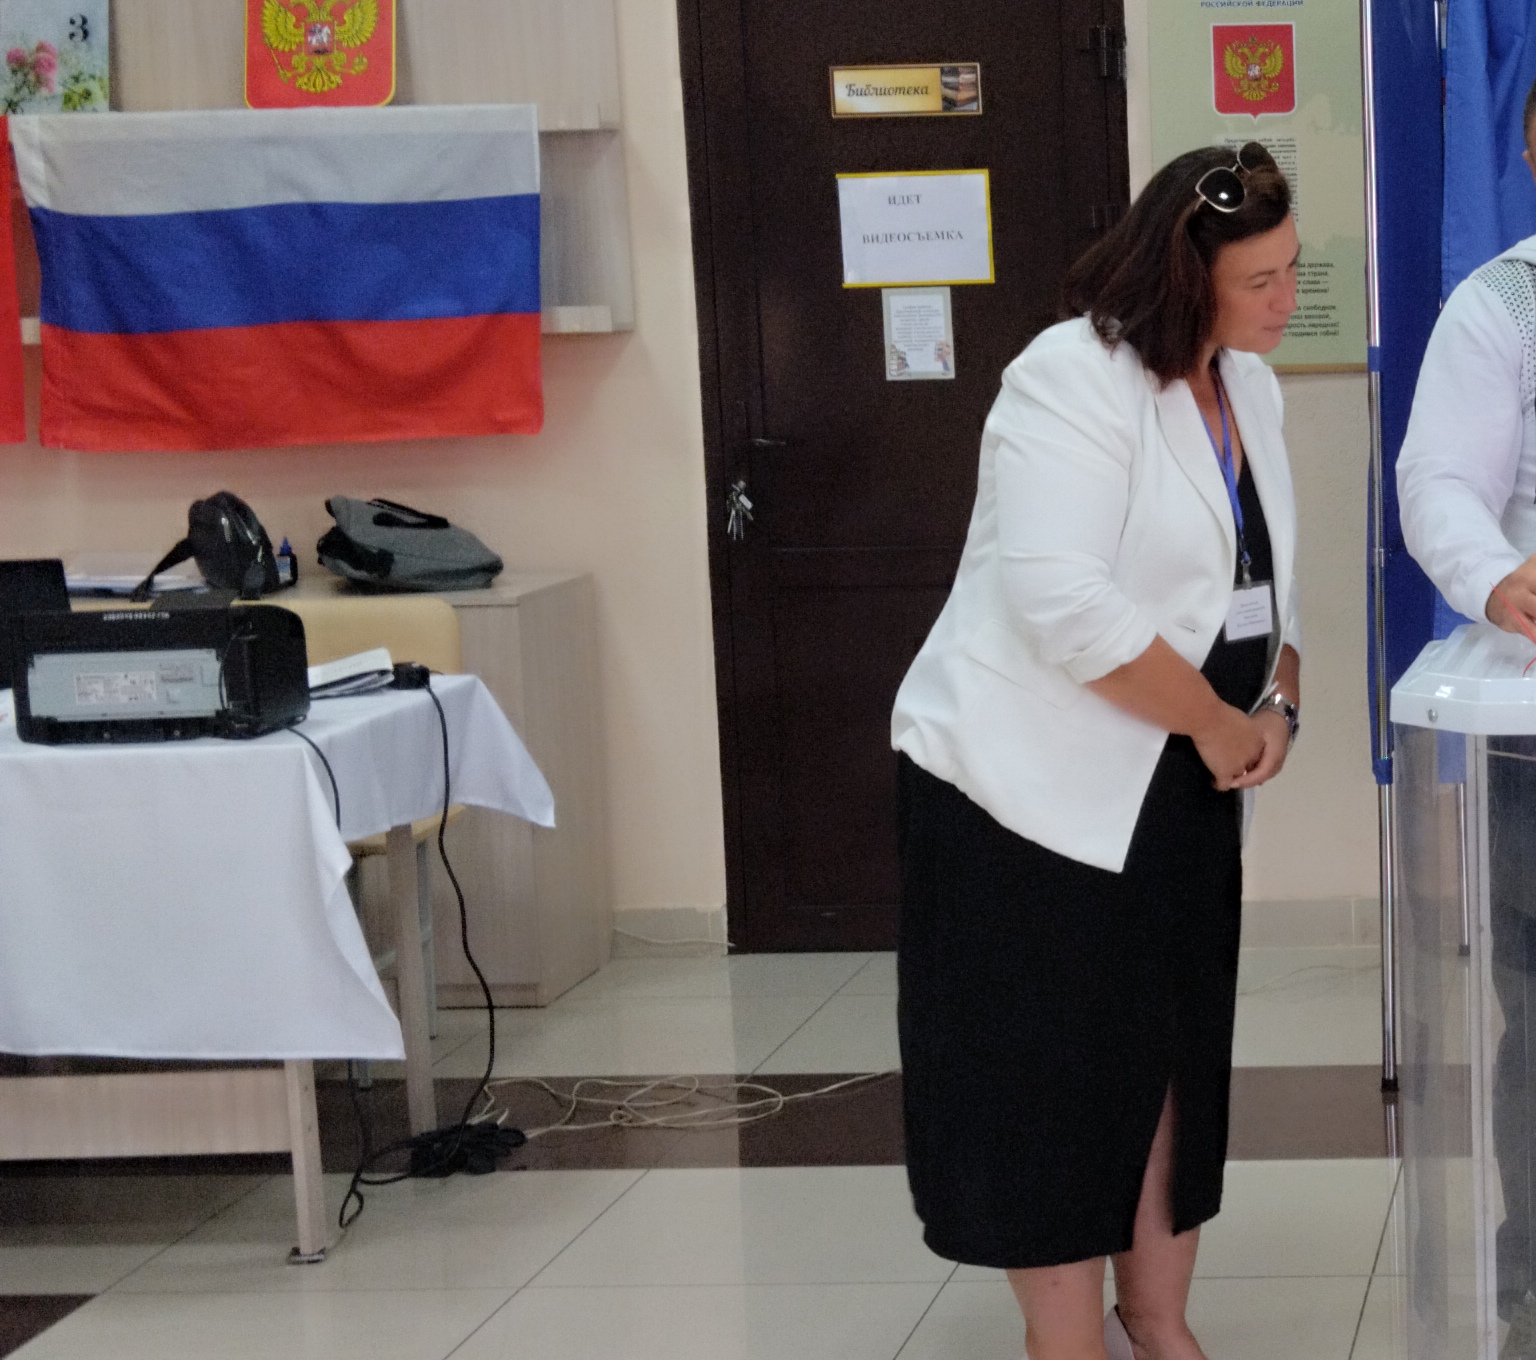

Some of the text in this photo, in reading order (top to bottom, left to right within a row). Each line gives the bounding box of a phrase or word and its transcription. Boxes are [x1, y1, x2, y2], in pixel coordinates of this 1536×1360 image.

[1200, 0, 1304, 8] РОССИЙСКОЙ ФЕДЕРАЦИИ
[68, 14, 90, 42] 3
[845, 83, 929, 97] Библиотека
[888, 194, 922, 206] ИДЕТ
[862, 230, 963, 244] ВИДЕОСЪЕМКА
